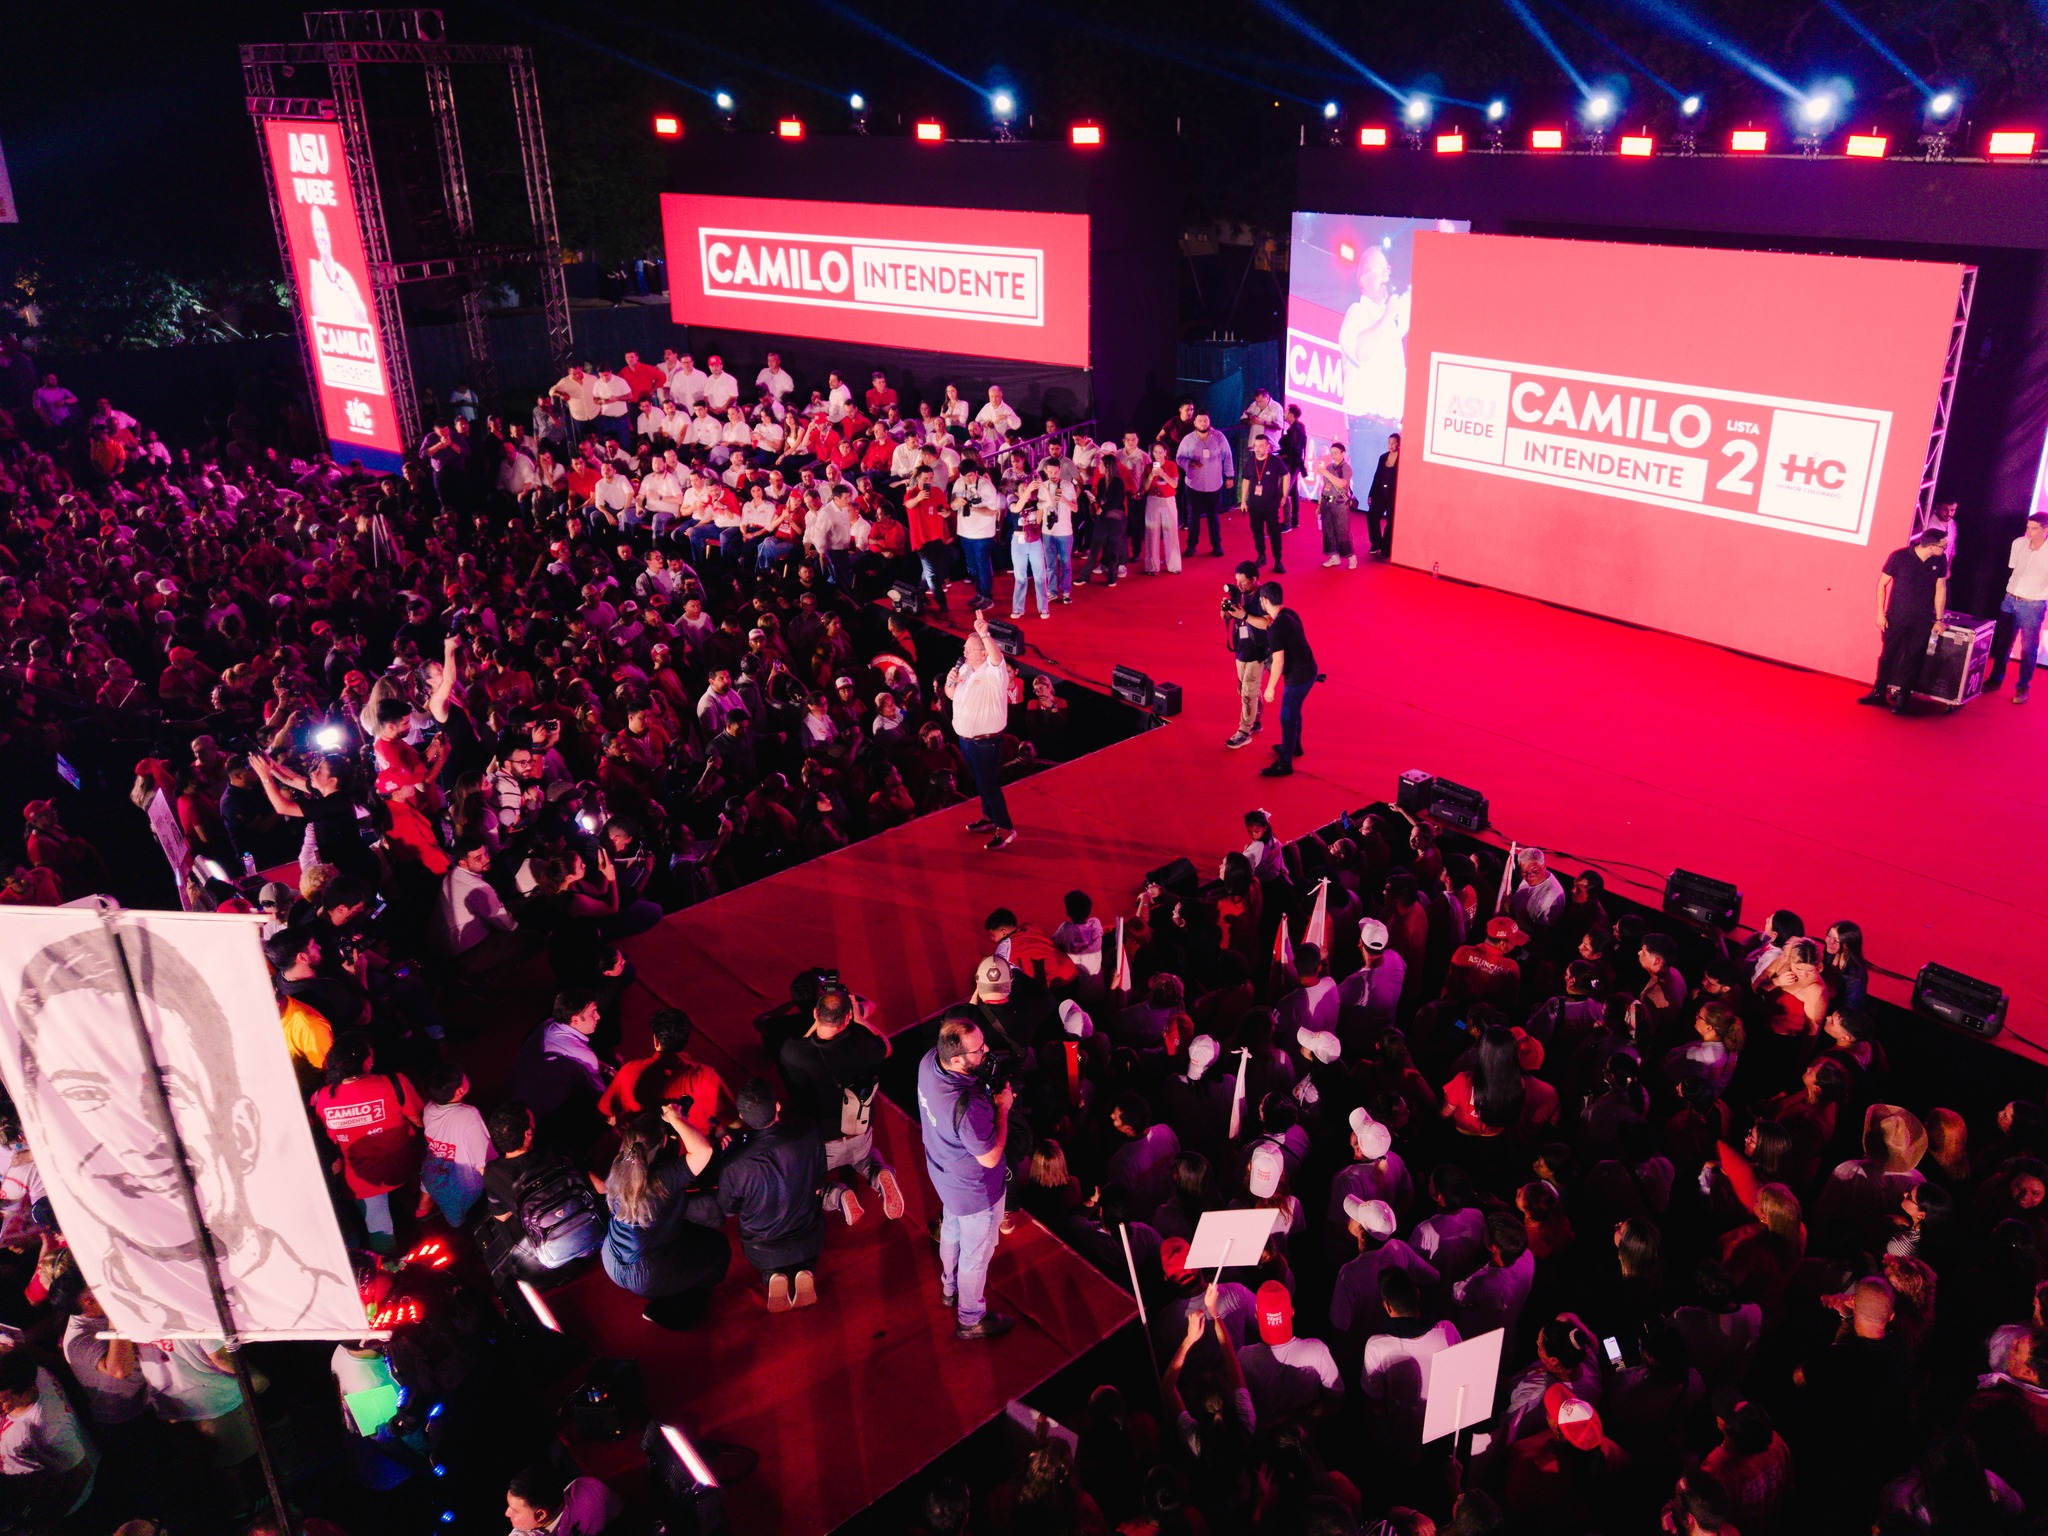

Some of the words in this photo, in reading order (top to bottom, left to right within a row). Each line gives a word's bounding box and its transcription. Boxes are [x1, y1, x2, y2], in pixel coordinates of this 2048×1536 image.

[288, 133, 329, 174] ASU
[292, 178, 338, 206] PUEDE
[706, 241, 850, 294] CAMILO
[863, 260, 1025, 301] INTENDENTE
[318, 326, 374, 360] CAMILO
[1444, 417, 1494, 438] PUEDE
[1511, 381, 1712, 449] CAMILO
[1726, 419, 1761, 435] LISTA
[1523, 440, 1684, 489] INTENDENTE
[1716, 438, 1760, 495] 2
[1779, 454, 1846, 490] HC
[327, 1105, 371, 1119] CAMILO
[373, 1107, 383, 1118] 2
